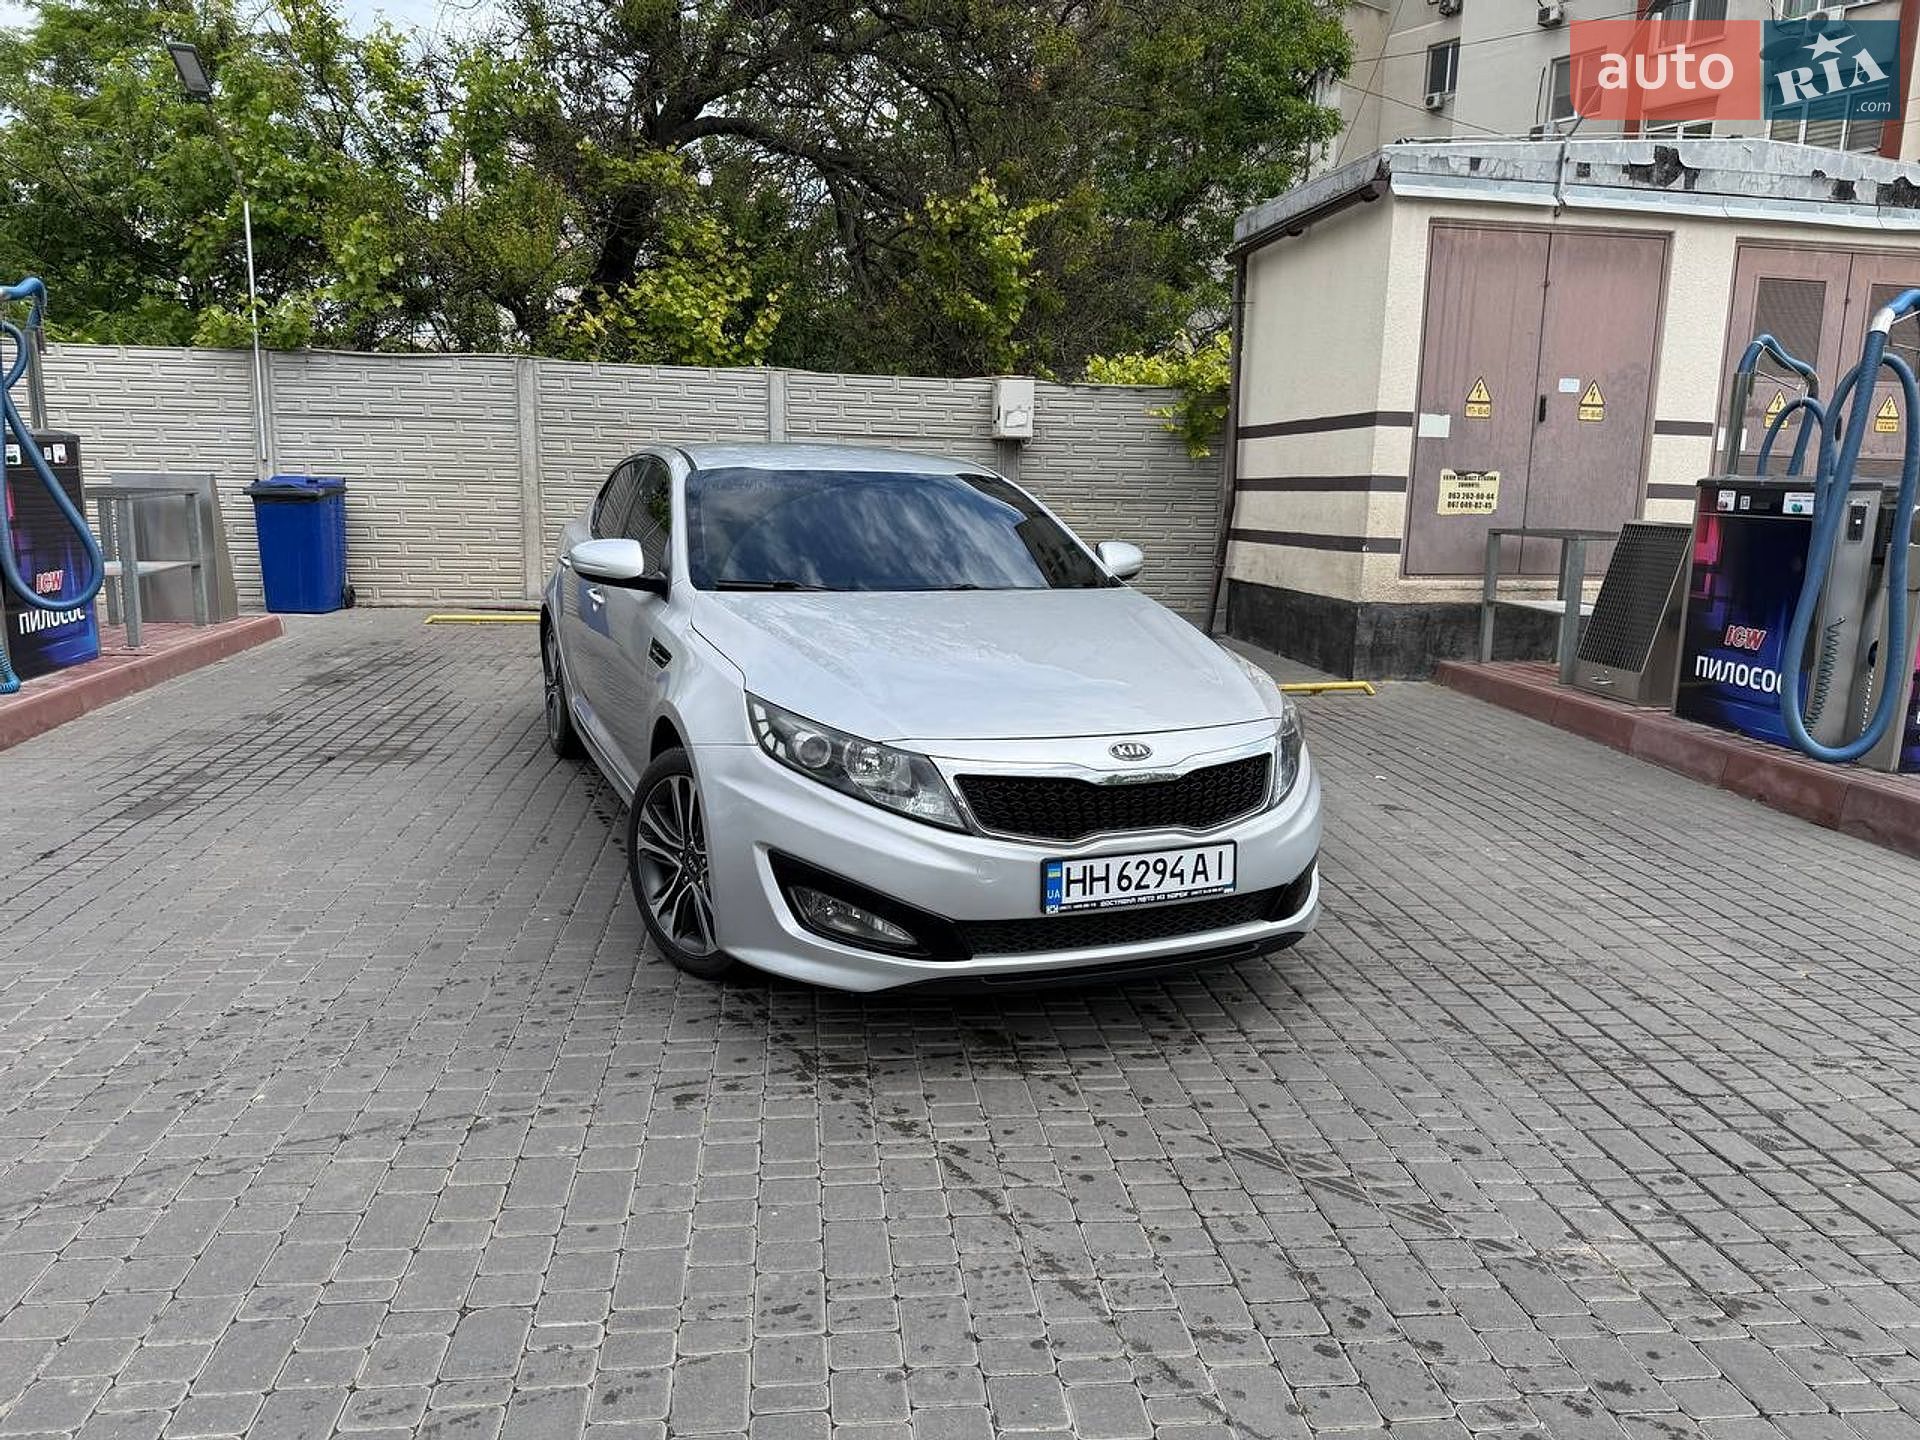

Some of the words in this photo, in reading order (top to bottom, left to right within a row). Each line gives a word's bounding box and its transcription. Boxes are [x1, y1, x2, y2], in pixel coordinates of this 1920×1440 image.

[1724, 624, 1767, 651] ICW
[1117, 744, 1147, 756] KIA
[1117, 855, 1184, 892] 6294
[1047, 889, 1061, 900] UA
